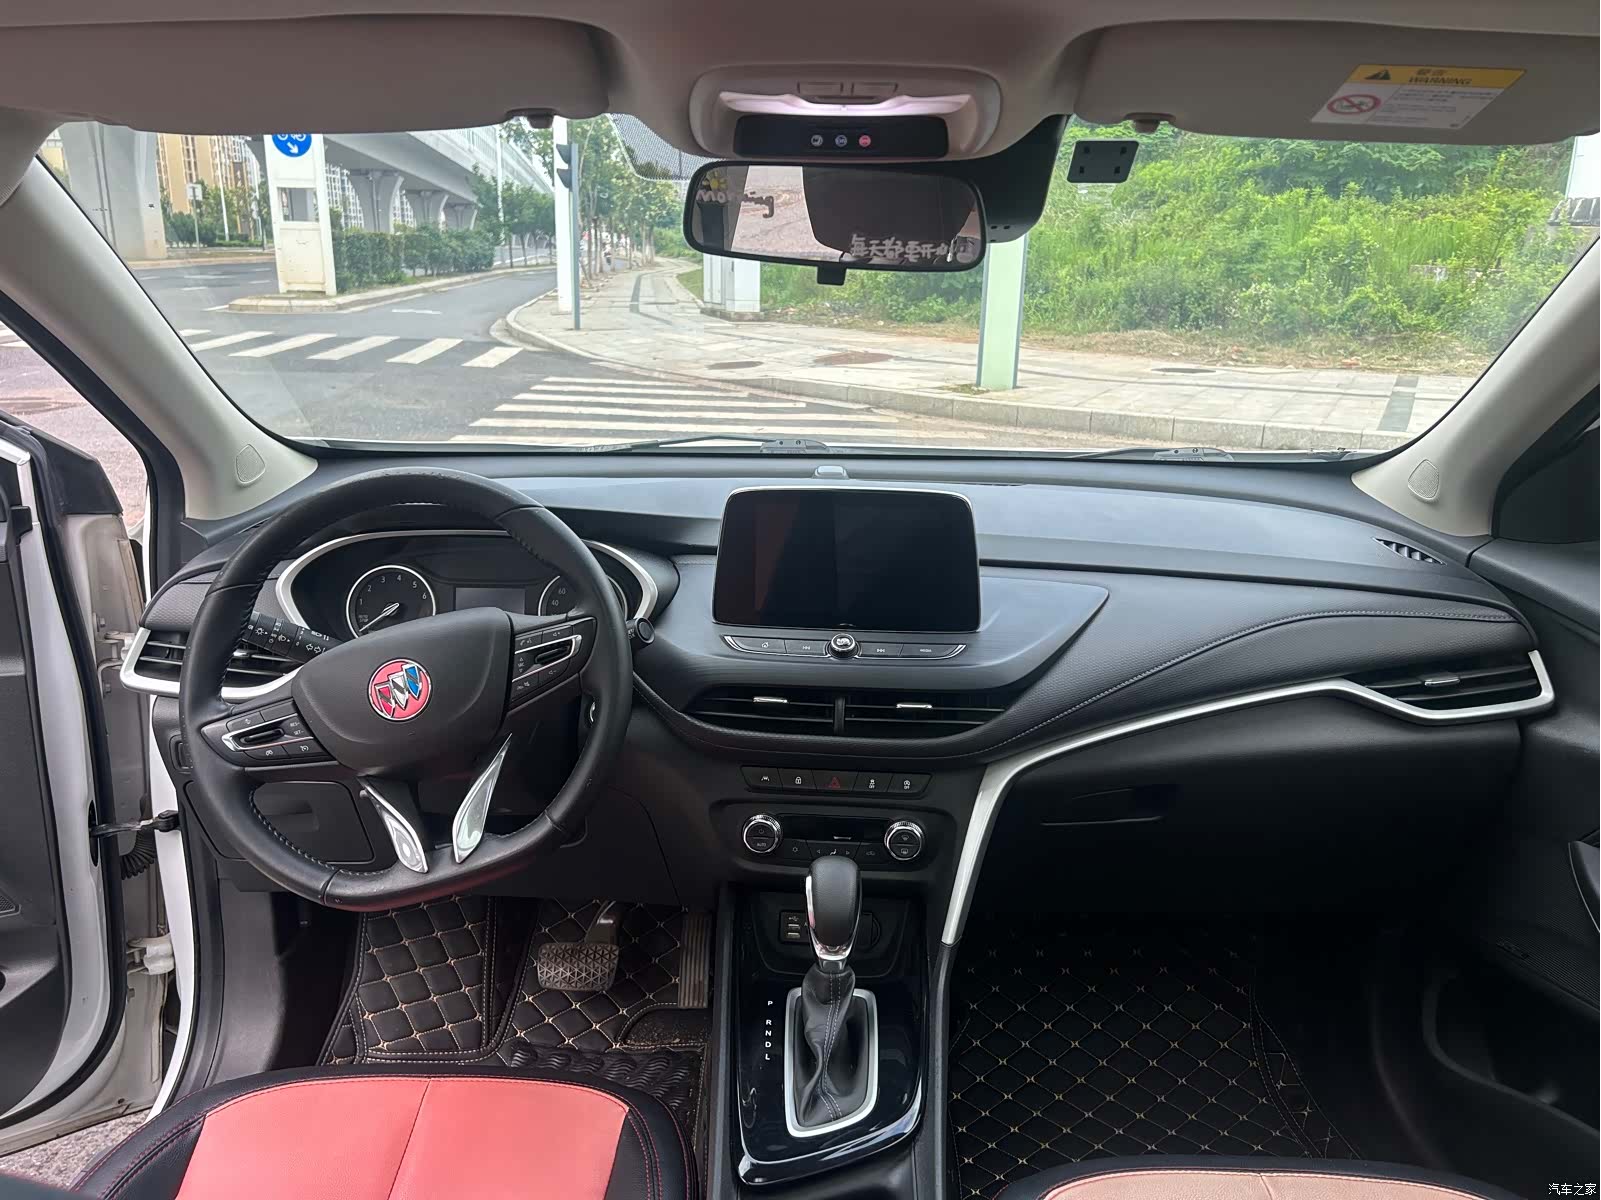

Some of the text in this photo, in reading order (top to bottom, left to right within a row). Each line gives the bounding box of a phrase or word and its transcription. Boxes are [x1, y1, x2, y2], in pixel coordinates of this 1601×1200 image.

[1408, 76, 1472, 85] WARNING
[367, 584, 372, 592] 2
[558, 587, 566, 595] 60
[765, 1029, 772, 1037] N
[765, 1053, 771, 1061] L
